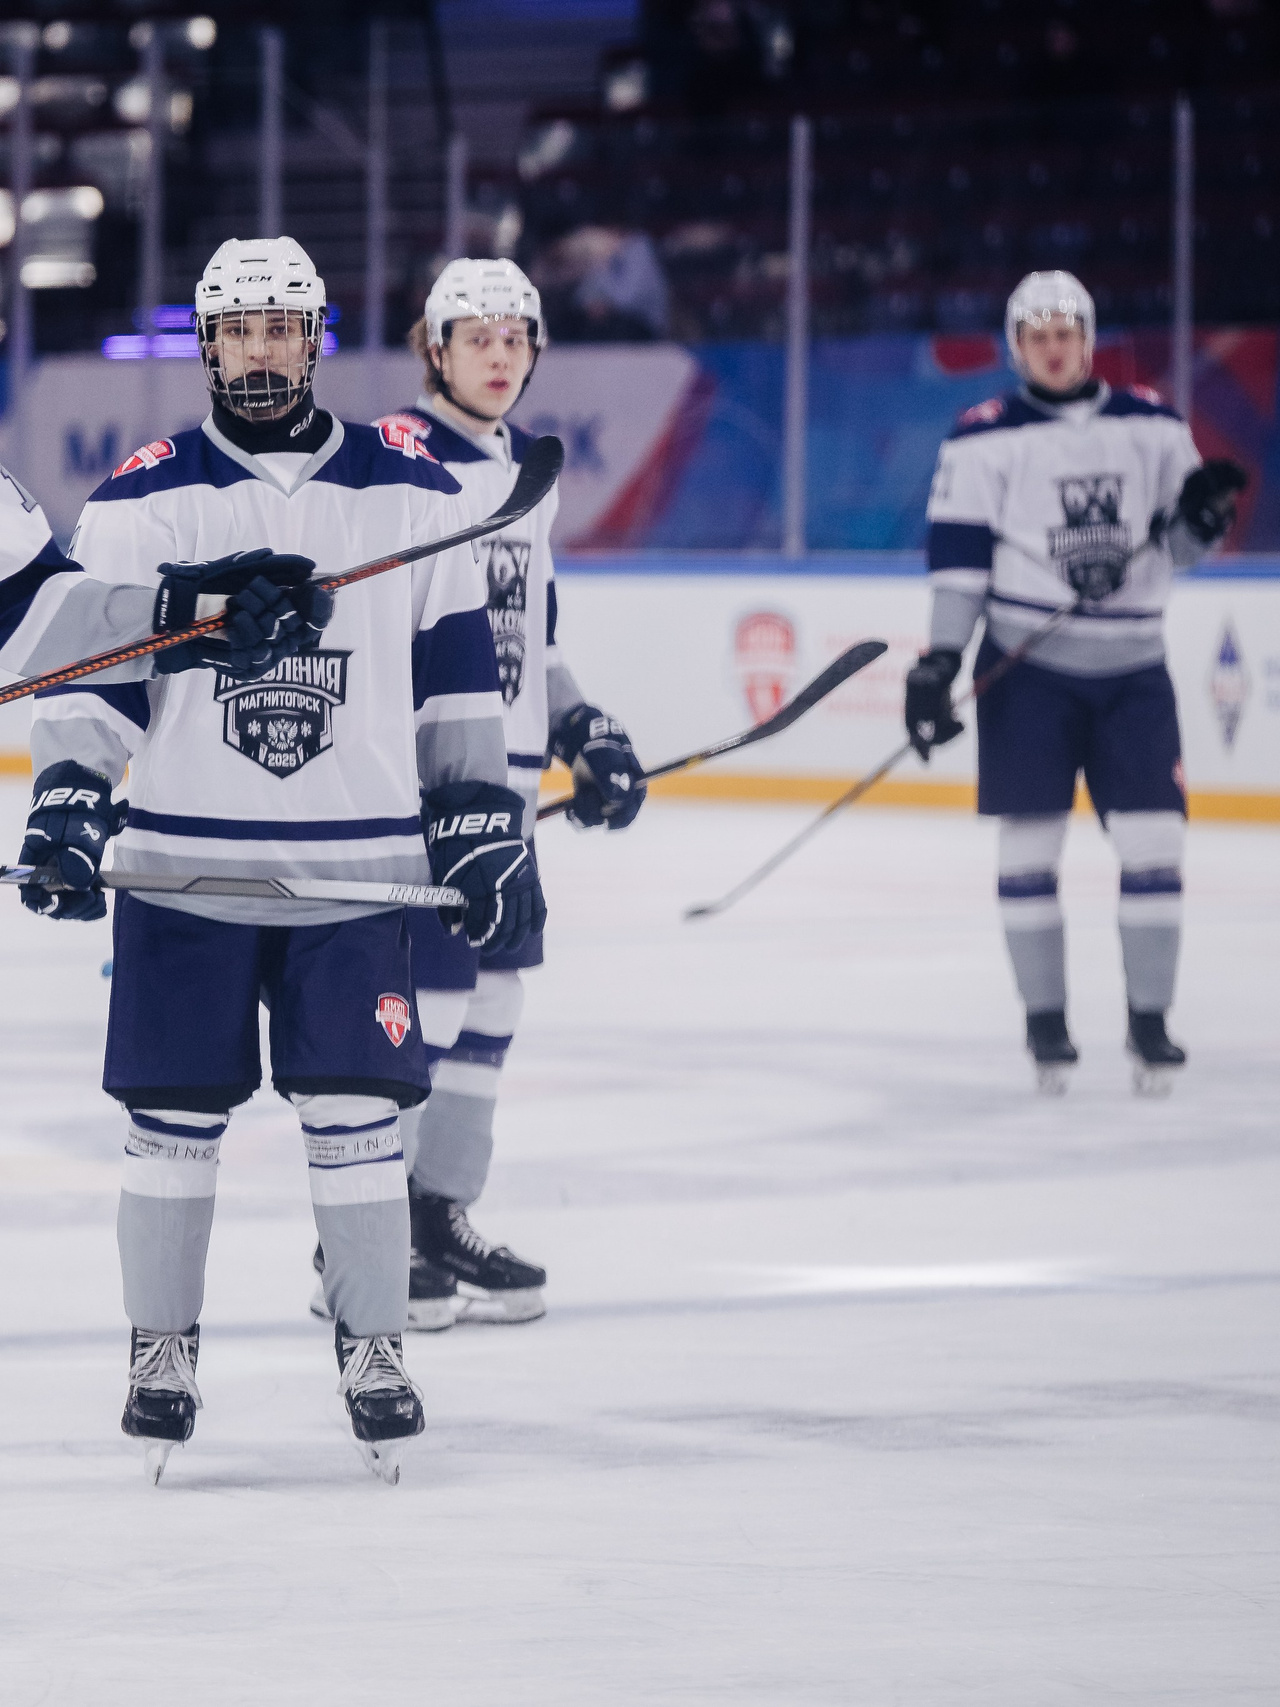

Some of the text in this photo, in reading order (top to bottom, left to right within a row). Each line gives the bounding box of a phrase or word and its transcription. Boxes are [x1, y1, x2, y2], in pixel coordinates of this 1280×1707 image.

[235, 275, 273, 284] CCM
[267, 752, 297, 768] 2025
[30, 787, 101, 813] UER
